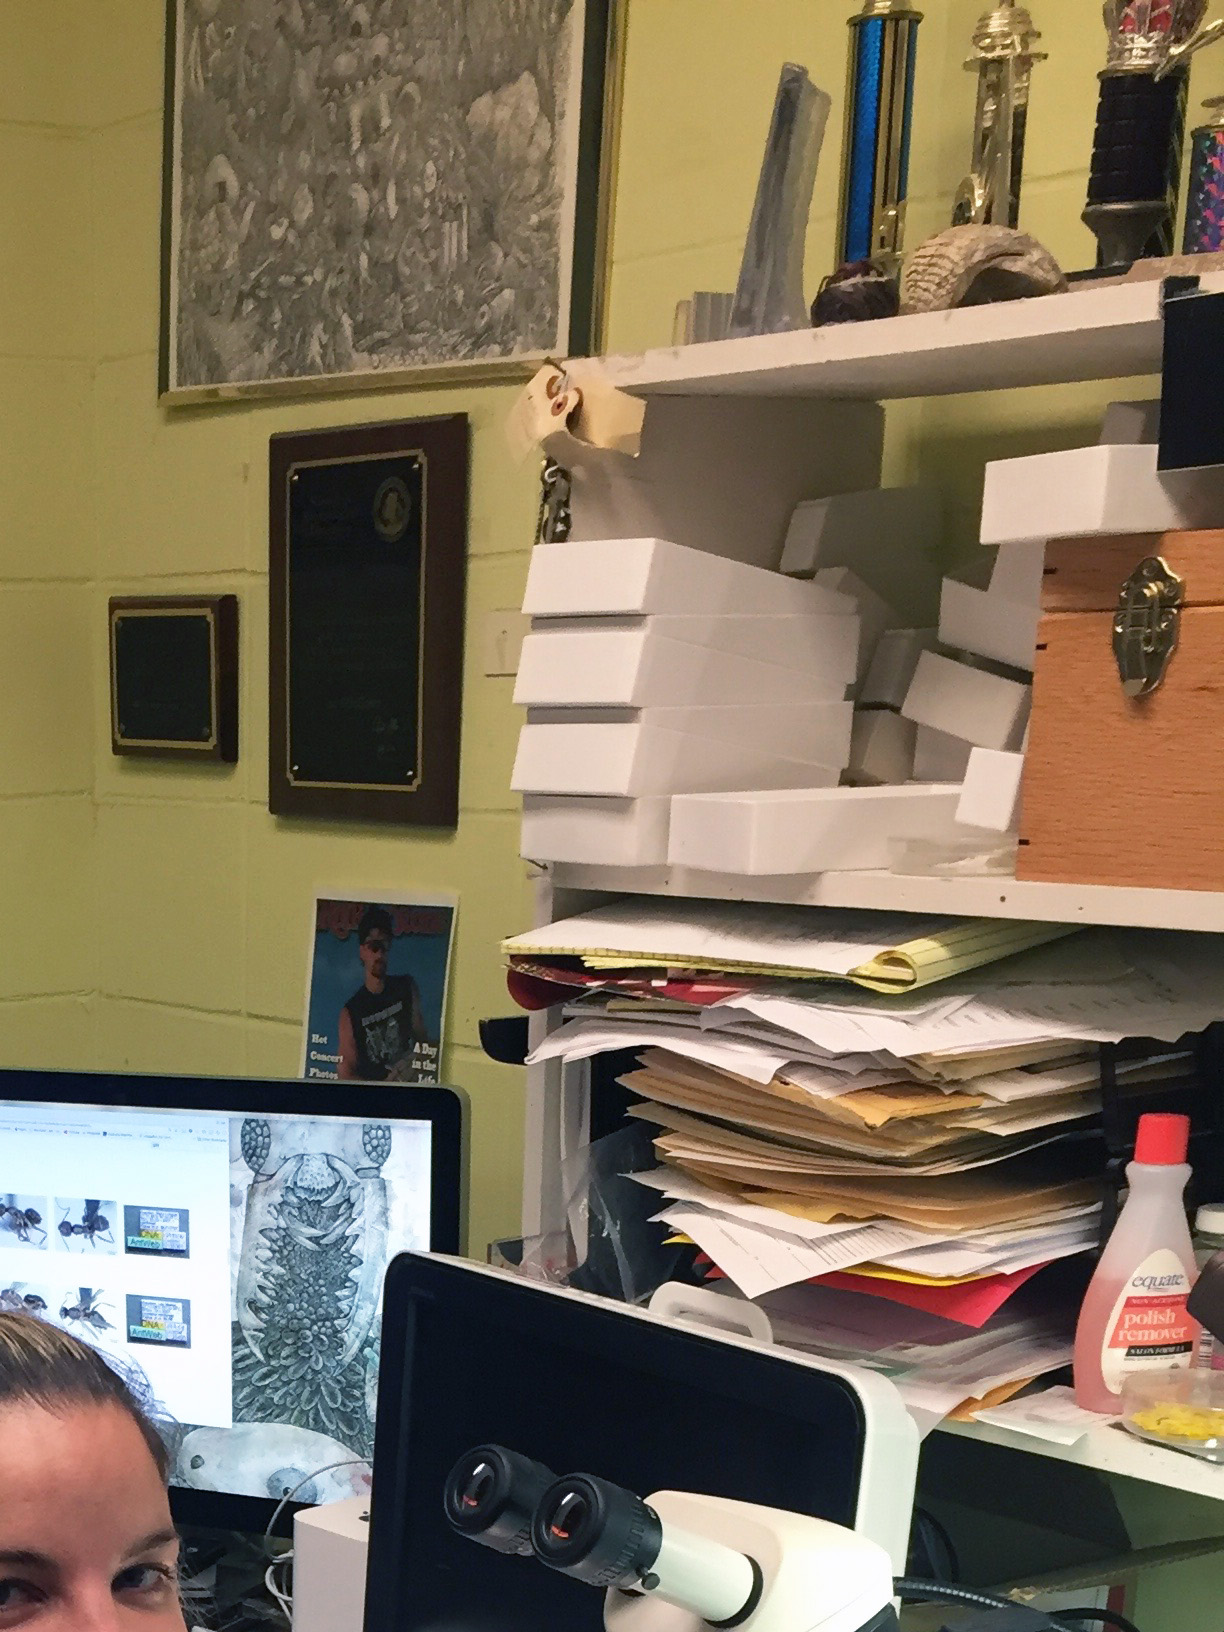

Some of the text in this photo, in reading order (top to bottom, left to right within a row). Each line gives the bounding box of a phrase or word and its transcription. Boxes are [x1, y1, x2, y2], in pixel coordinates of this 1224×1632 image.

[310, 1051, 343, 1063] Concert
[413, 1042, 438, 1059] A Day
[309, 1067, 338, 1080] Photos
[412, 1059, 436, 1072] in the
[1131, 1273, 1184, 1290] equate
[1124, 1308, 1176, 1329] polish
[1118, 1326, 1187, 1342] remover
